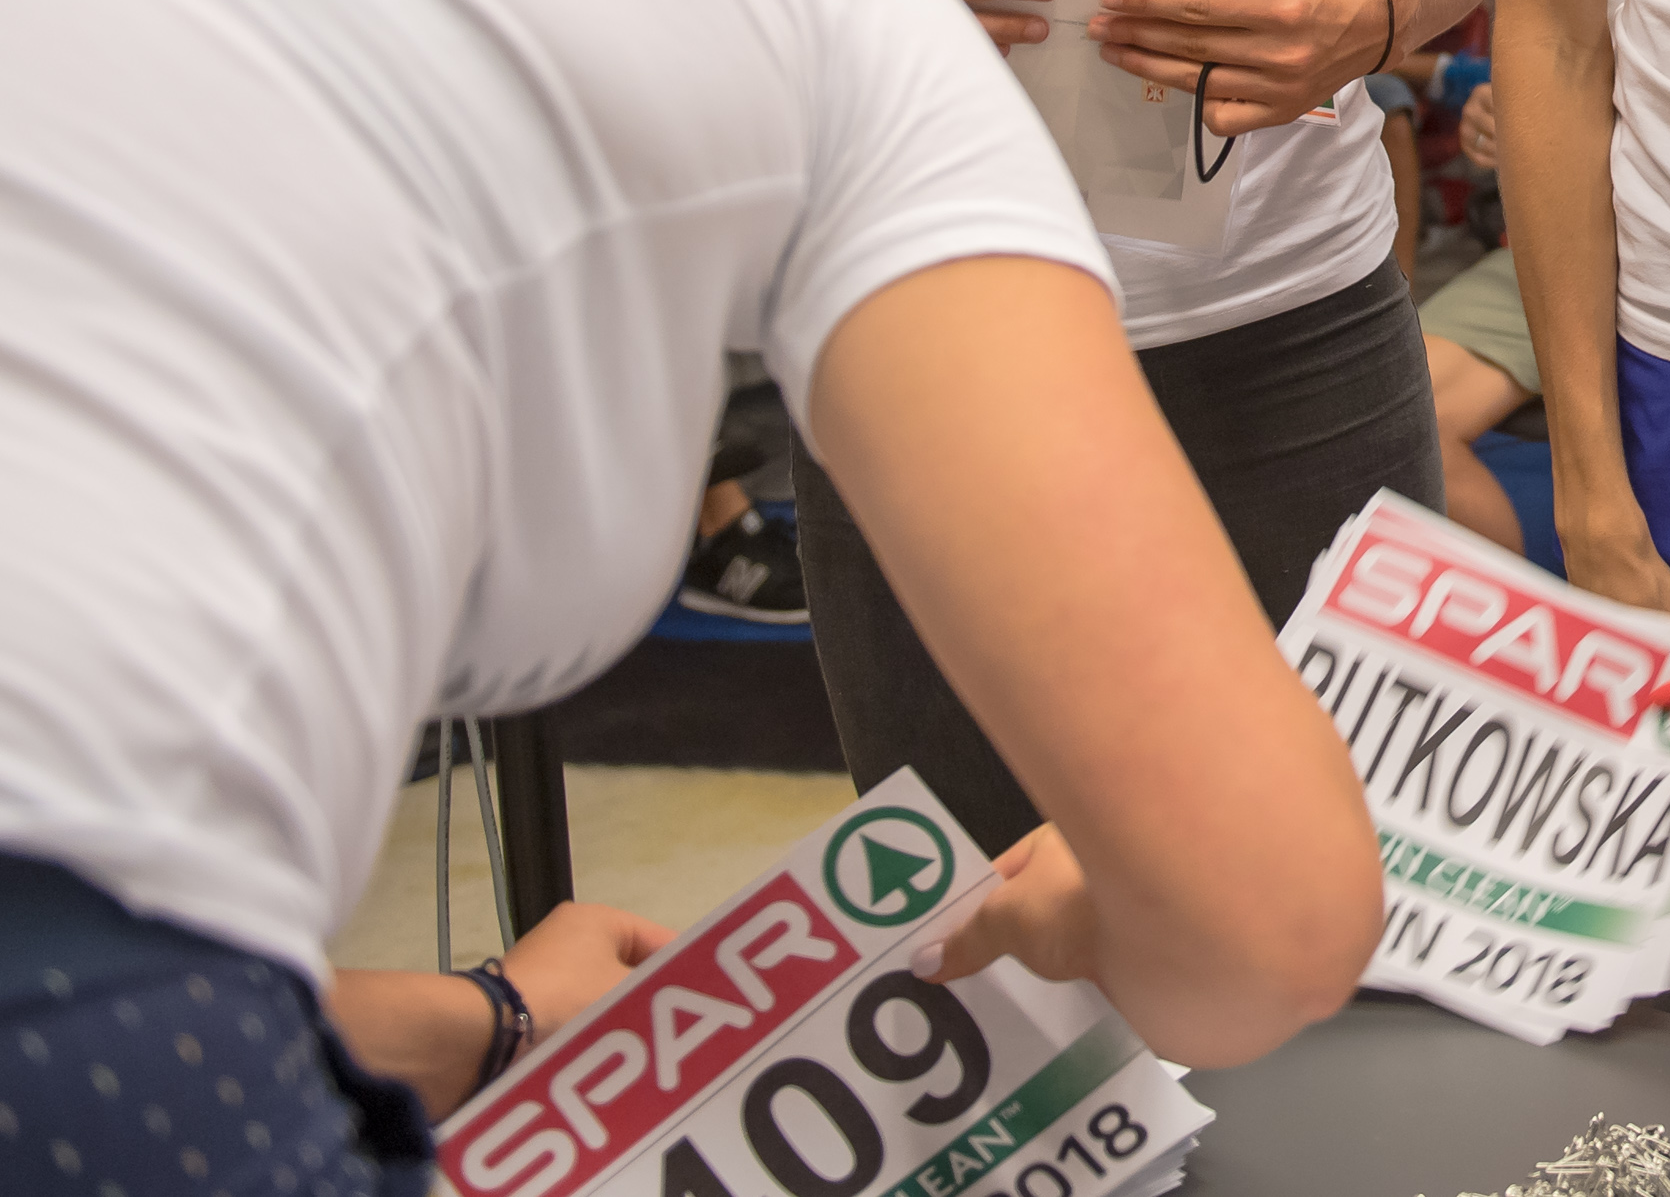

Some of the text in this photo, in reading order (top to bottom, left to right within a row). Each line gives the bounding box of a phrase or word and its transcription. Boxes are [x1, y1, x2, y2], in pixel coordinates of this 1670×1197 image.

[1337, 541, 1653, 728] SPAR
[1384, 899, 1596, 1007] IN 2018
[461, 898, 837, 1192] SPAR
[988, 1103, 1148, 1197] 018
